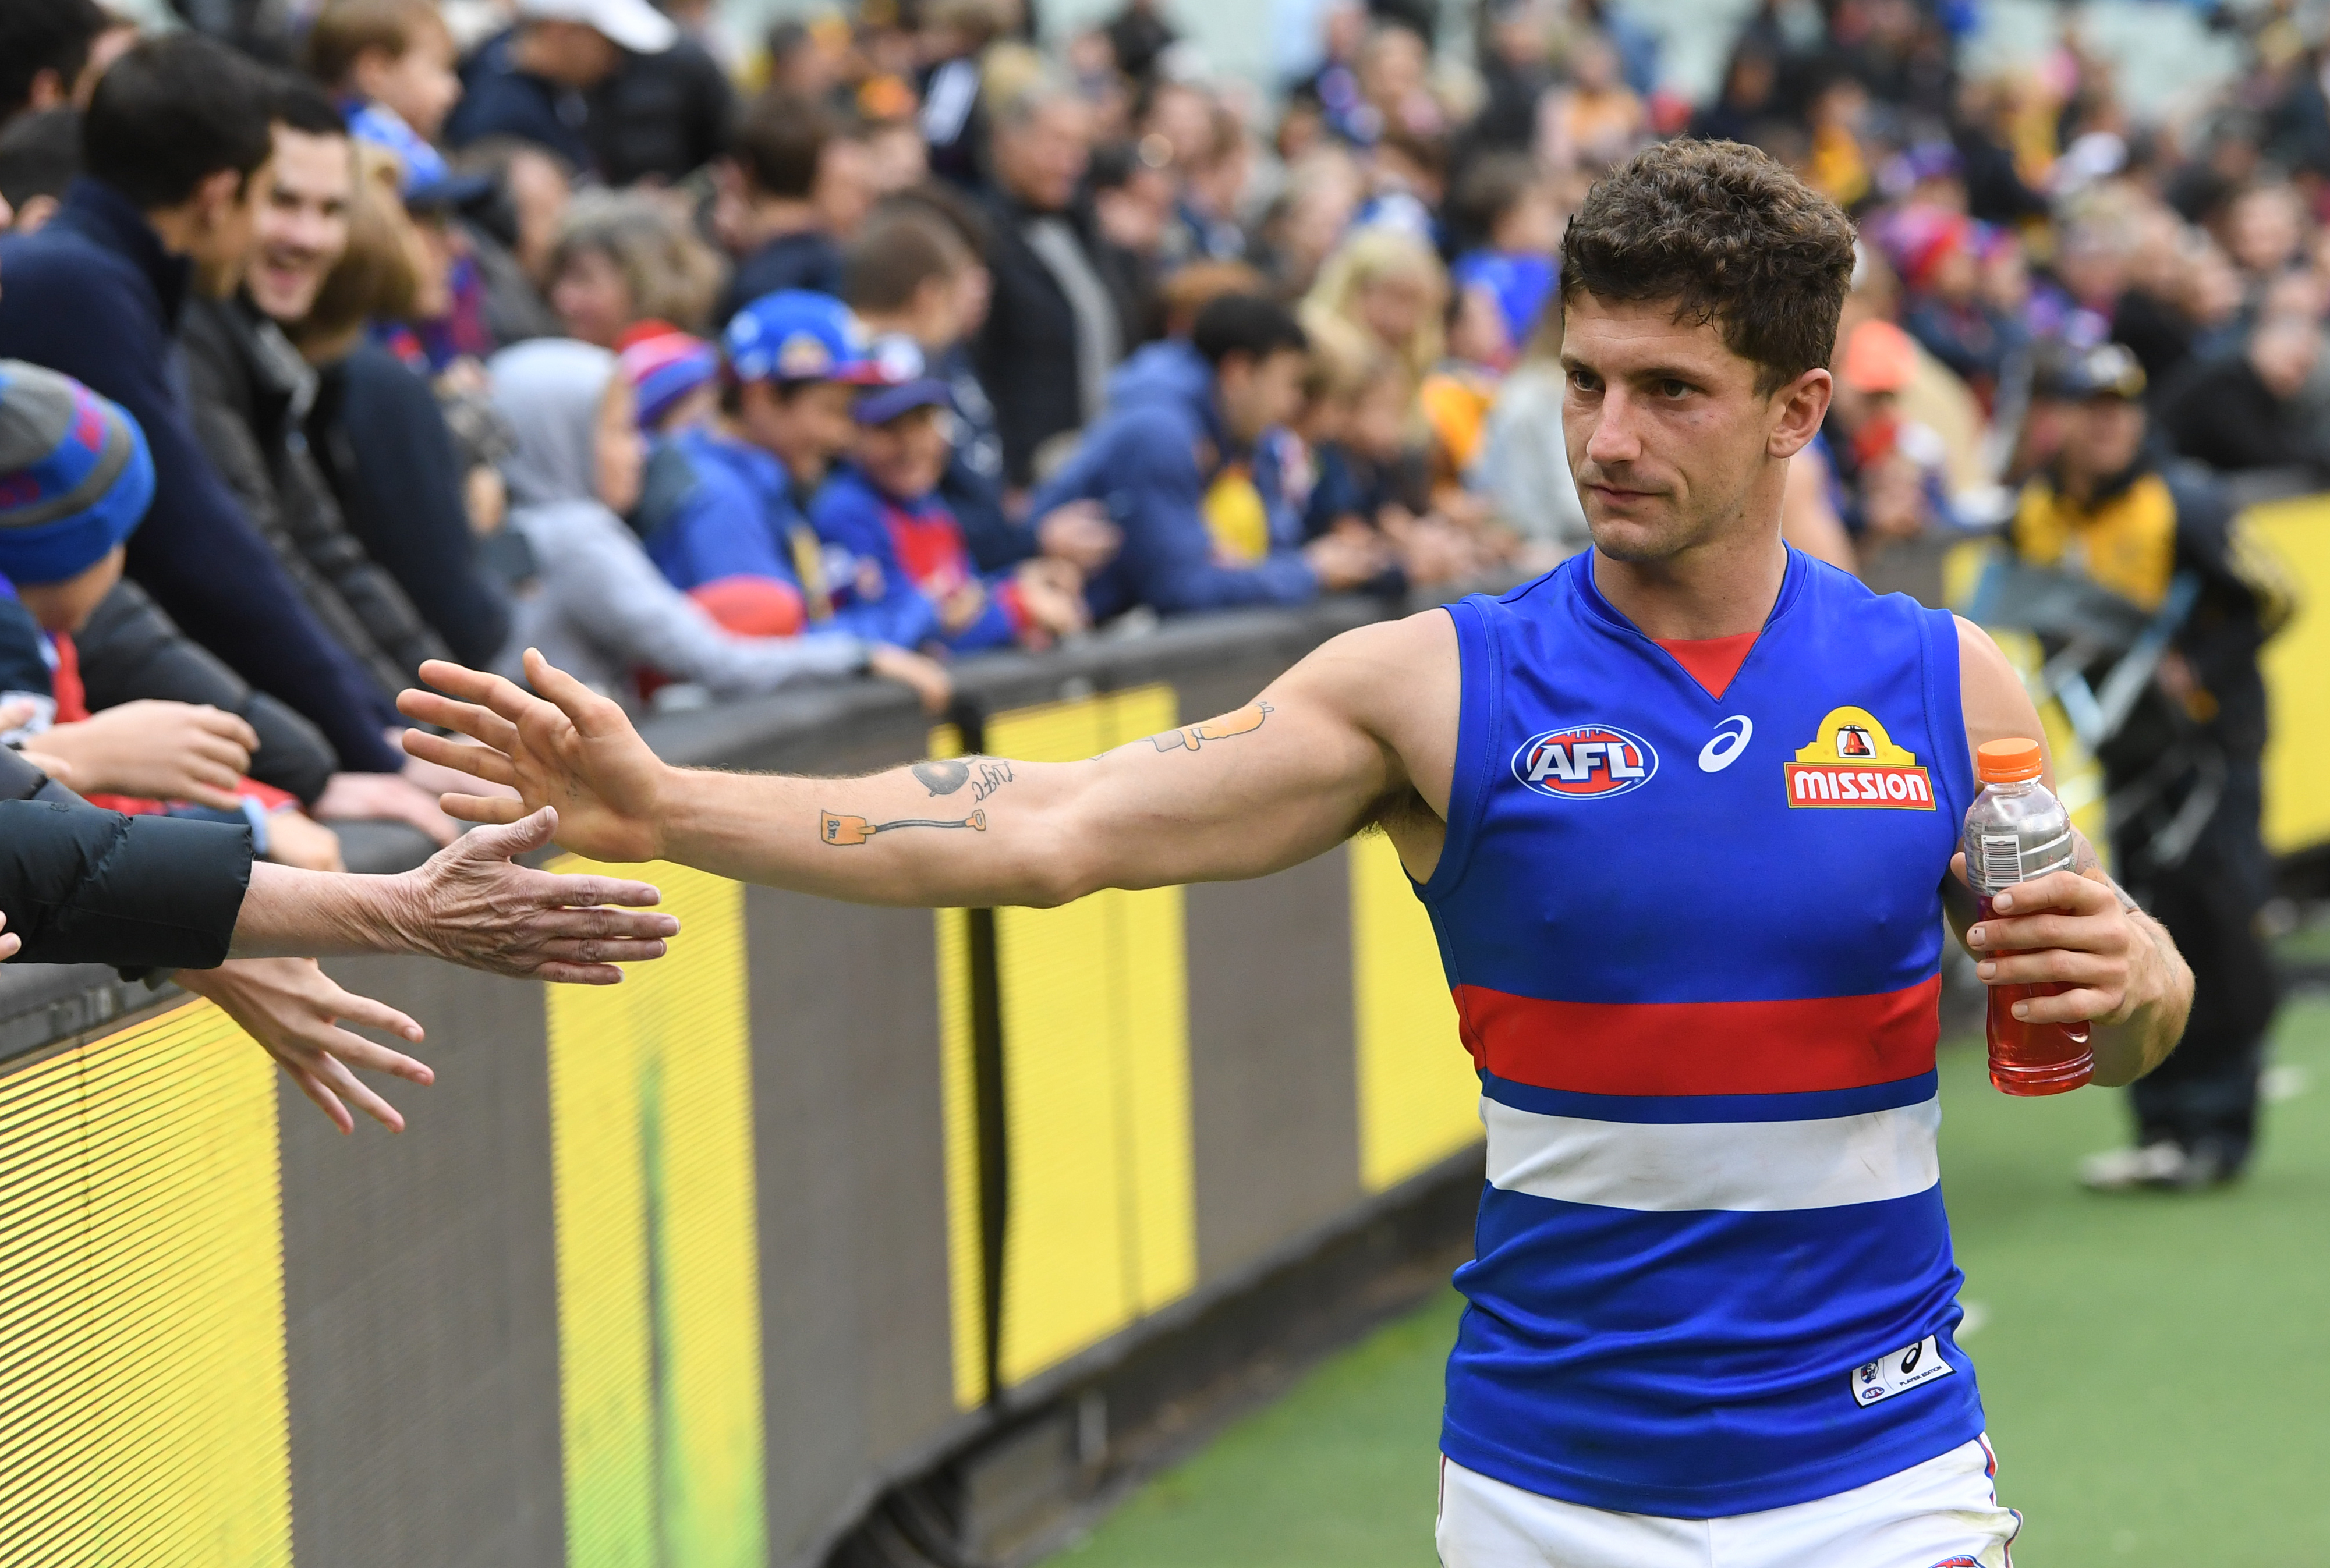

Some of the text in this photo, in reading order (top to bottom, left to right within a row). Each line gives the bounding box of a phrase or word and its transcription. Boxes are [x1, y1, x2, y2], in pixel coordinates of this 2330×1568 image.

[1528, 743, 1645, 781] AFL
[1794, 771, 1928, 801] MISSION
[1899, 1365, 1943, 1386] PLAYER EDITION
[1865, 1388, 1884, 1398] AFL
